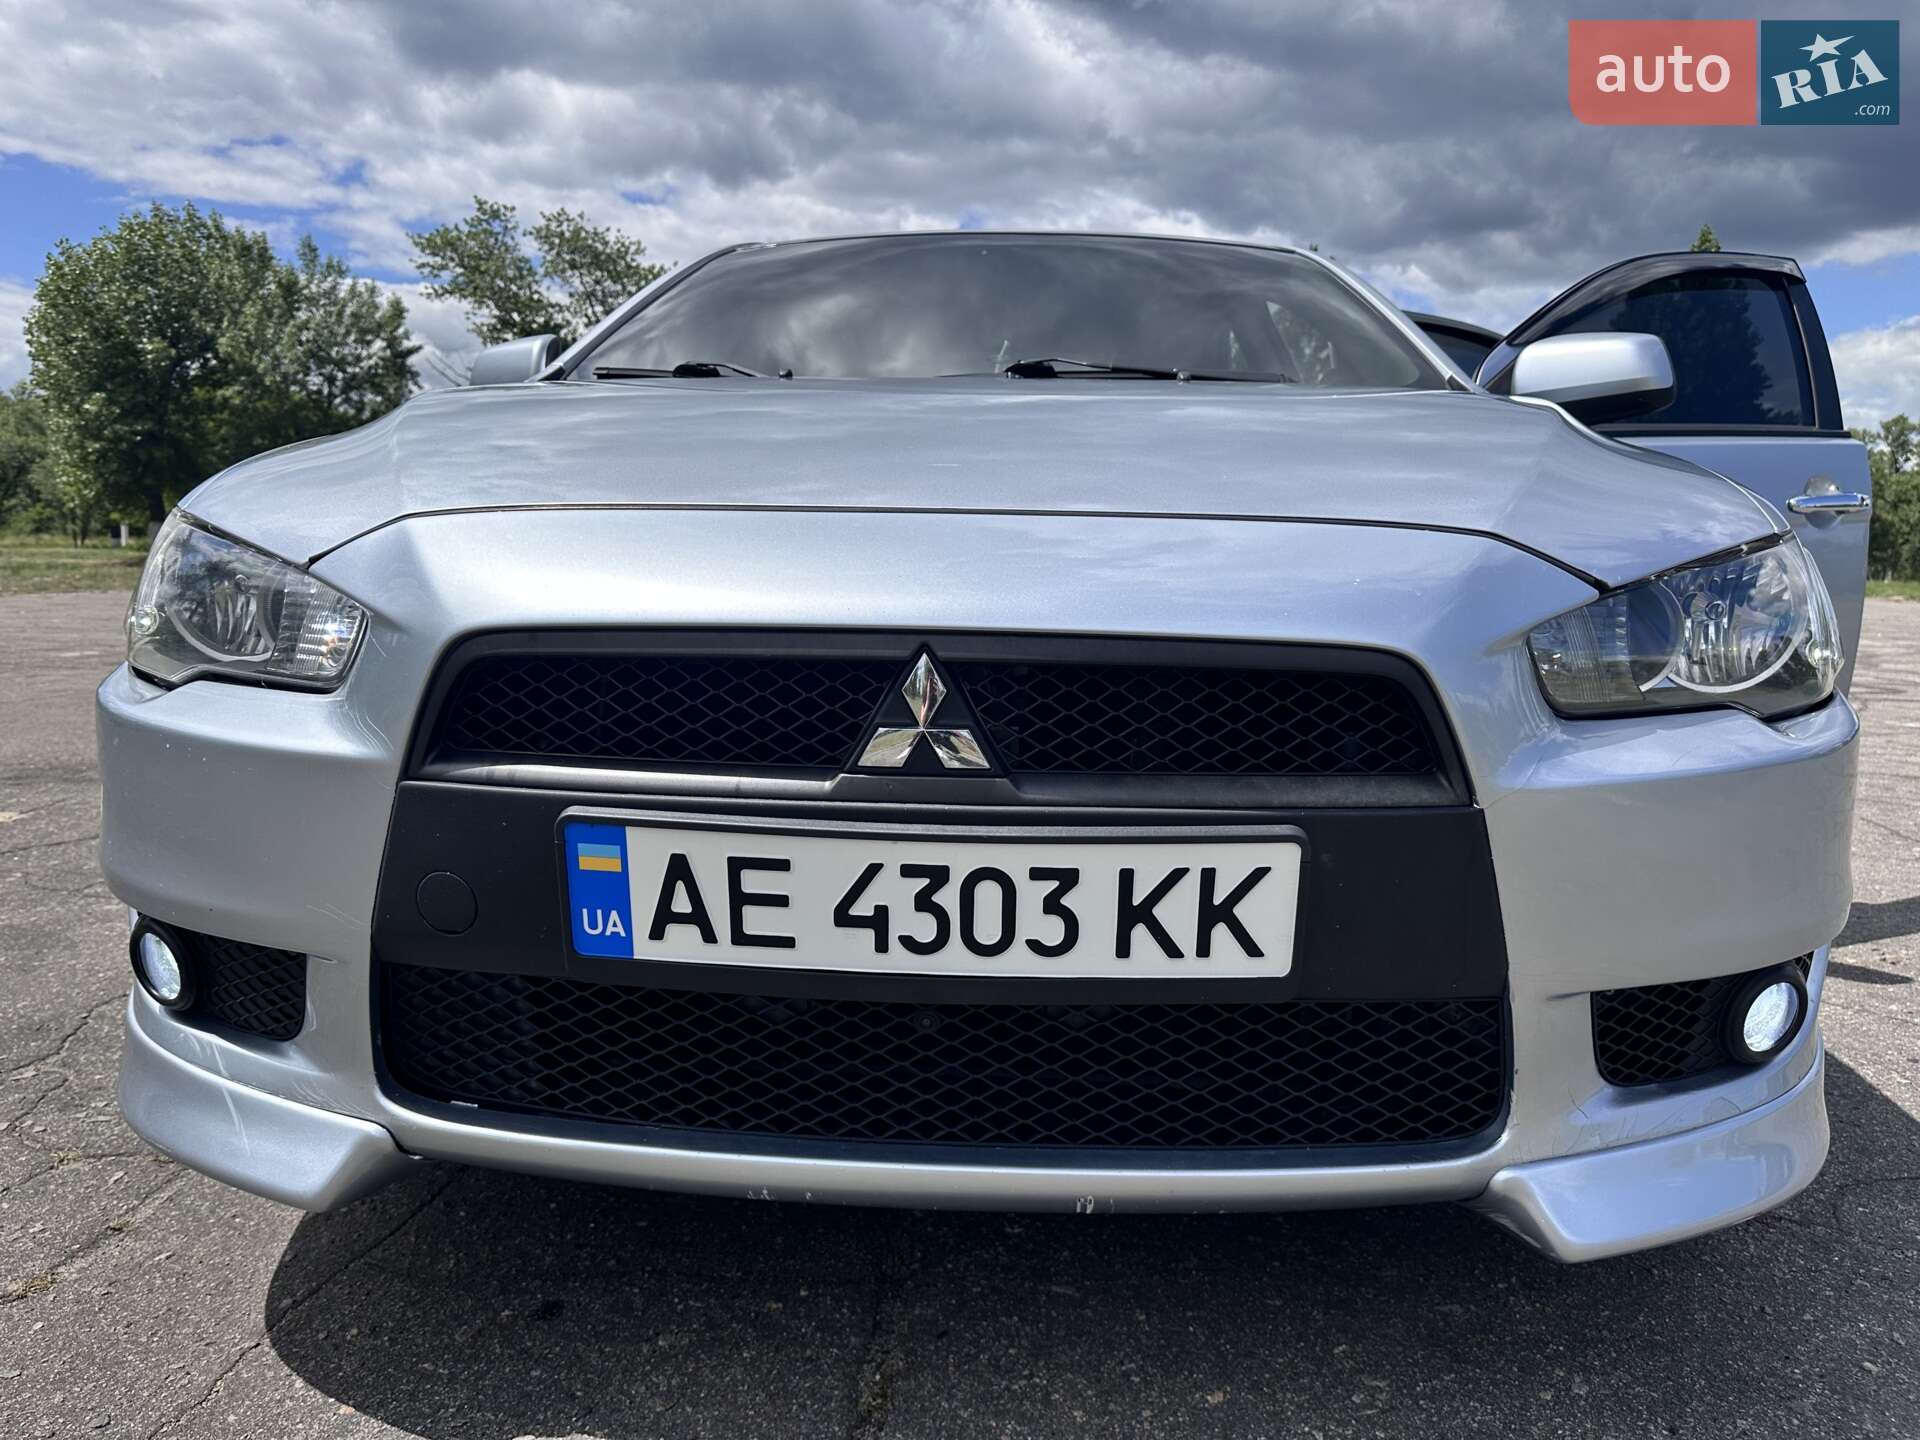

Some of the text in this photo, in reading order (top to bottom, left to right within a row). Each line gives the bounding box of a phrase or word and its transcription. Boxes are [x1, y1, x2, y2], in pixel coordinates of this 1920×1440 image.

[582, 907, 626, 937] UA
[648, 853, 1272, 959] AE 4303 KK
